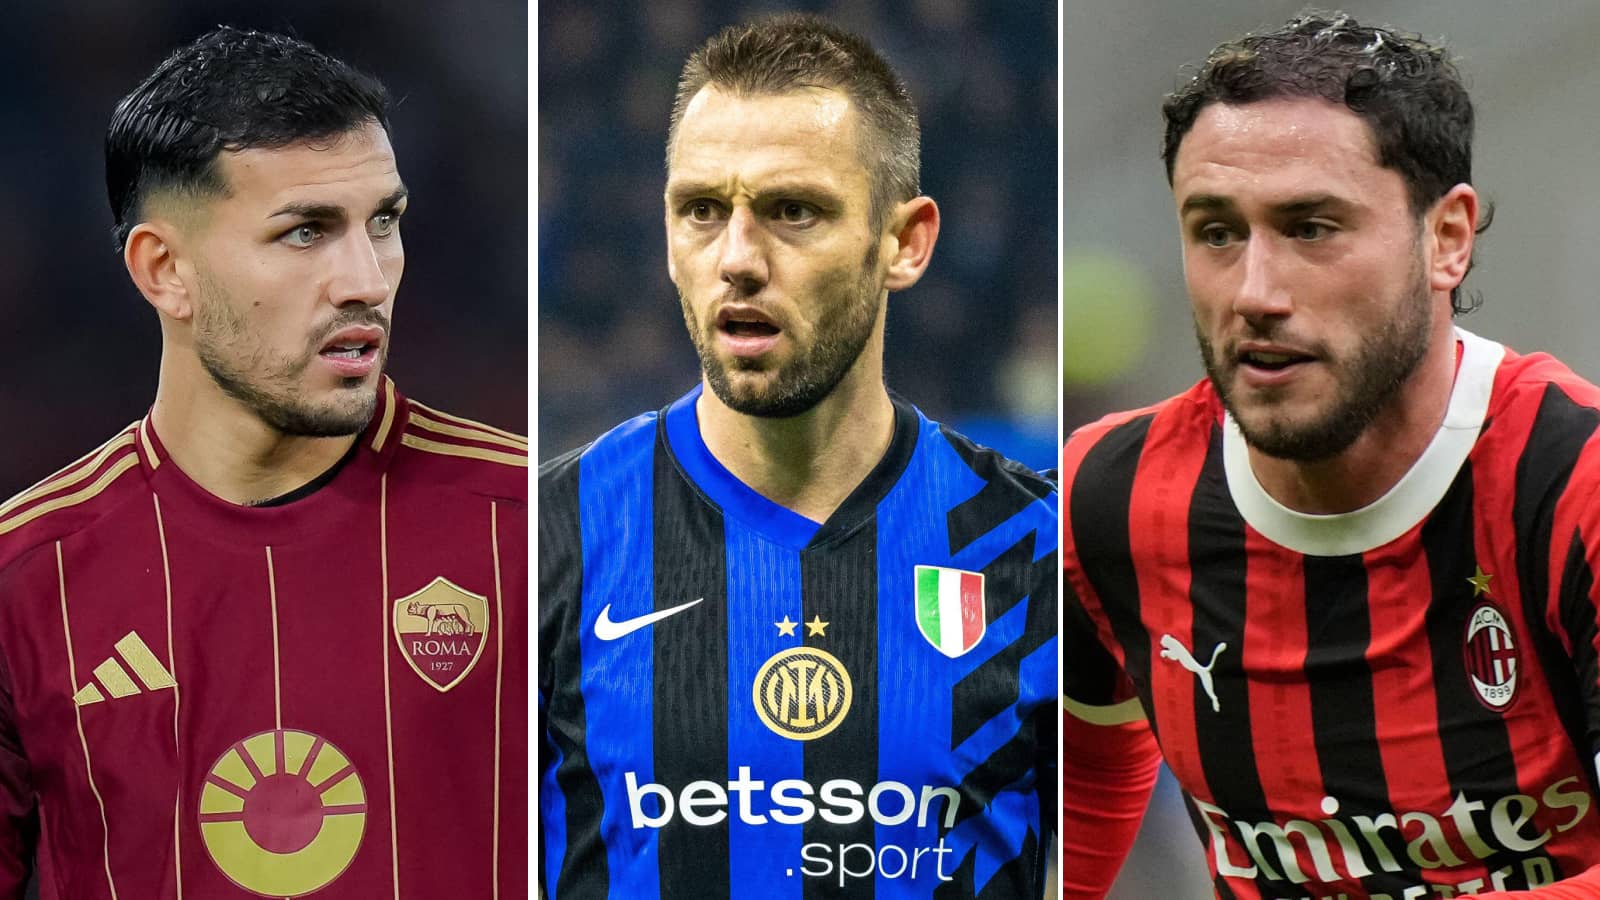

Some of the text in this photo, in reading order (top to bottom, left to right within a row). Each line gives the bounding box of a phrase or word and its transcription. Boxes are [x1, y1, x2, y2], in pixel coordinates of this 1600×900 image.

[1474, 610, 1500, 625] ACM
[412, 641, 471, 655] ROMA
[431, 662, 453, 671] 1927
[1484, 685, 1511, 699] 1899
[624, 766, 961, 828] betsson
[1193, 776, 1591, 883] Emirates
[785, 838, 954, 887] .sport
